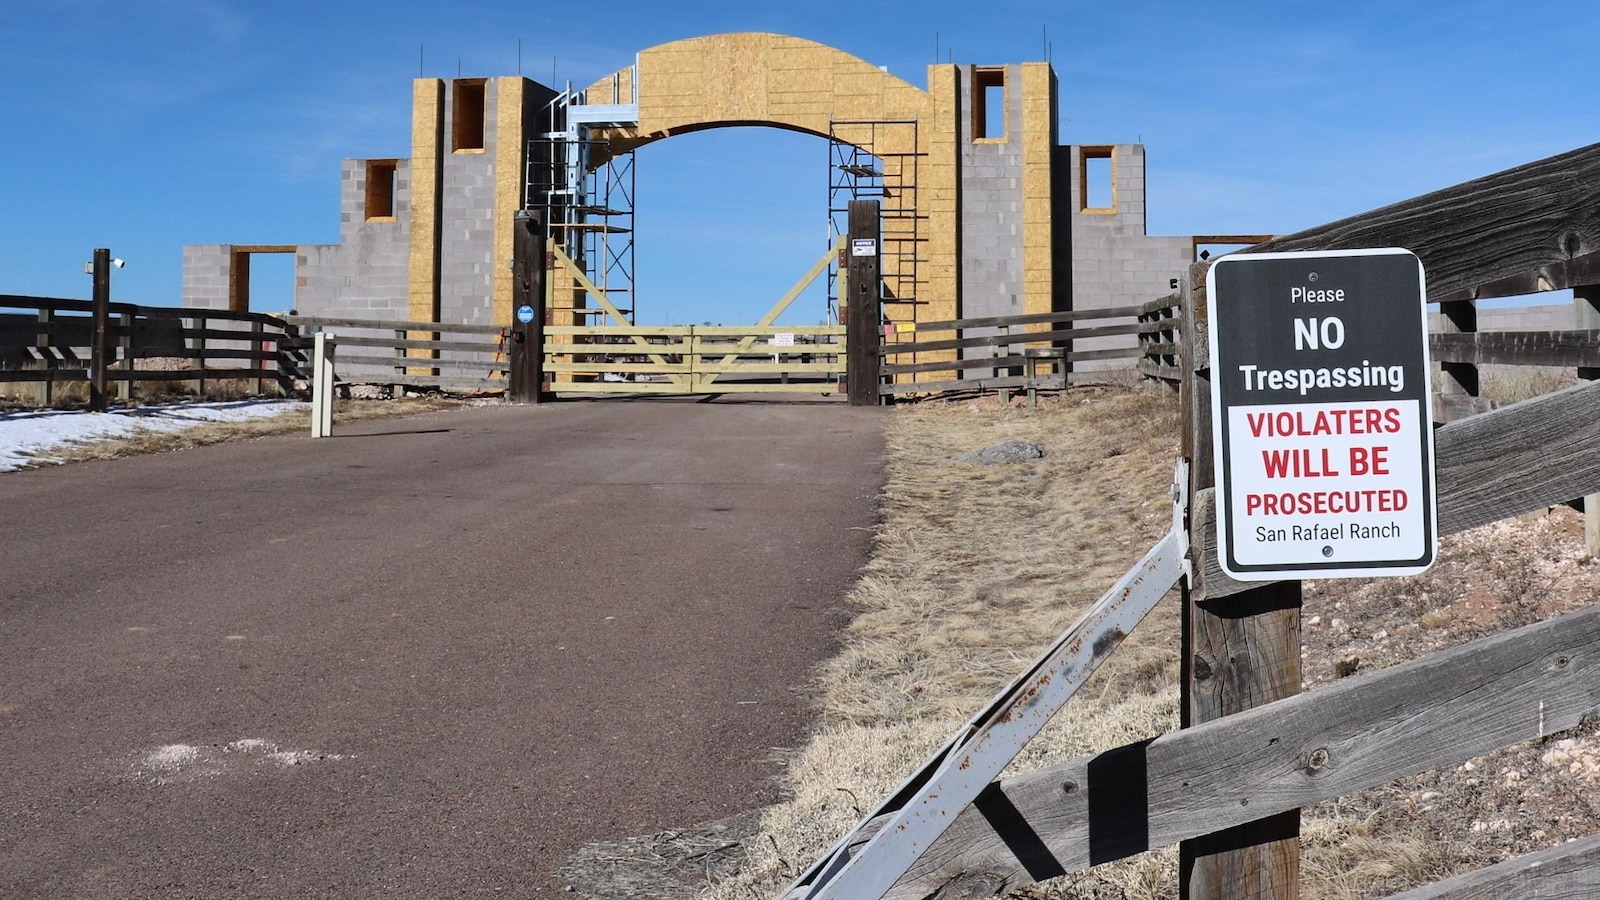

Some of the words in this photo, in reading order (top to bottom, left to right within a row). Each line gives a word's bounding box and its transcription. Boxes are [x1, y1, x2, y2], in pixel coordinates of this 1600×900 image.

[1291, 287, 1345, 304] Please
[1294, 317, 1345, 351] NO
[1239, 360, 1405, 396] Trespassing
[1247, 408, 1401, 438] VIOLATERS
[1263, 448, 1339, 479] WILL
[1349, 446, 1390, 477] BE
[1247, 489, 1408, 516] PROSECUTED
[1256, 526, 1287, 543] San
[1293, 523, 1344, 541] Rafael
[1351, 521, 1400, 539] Ranch
